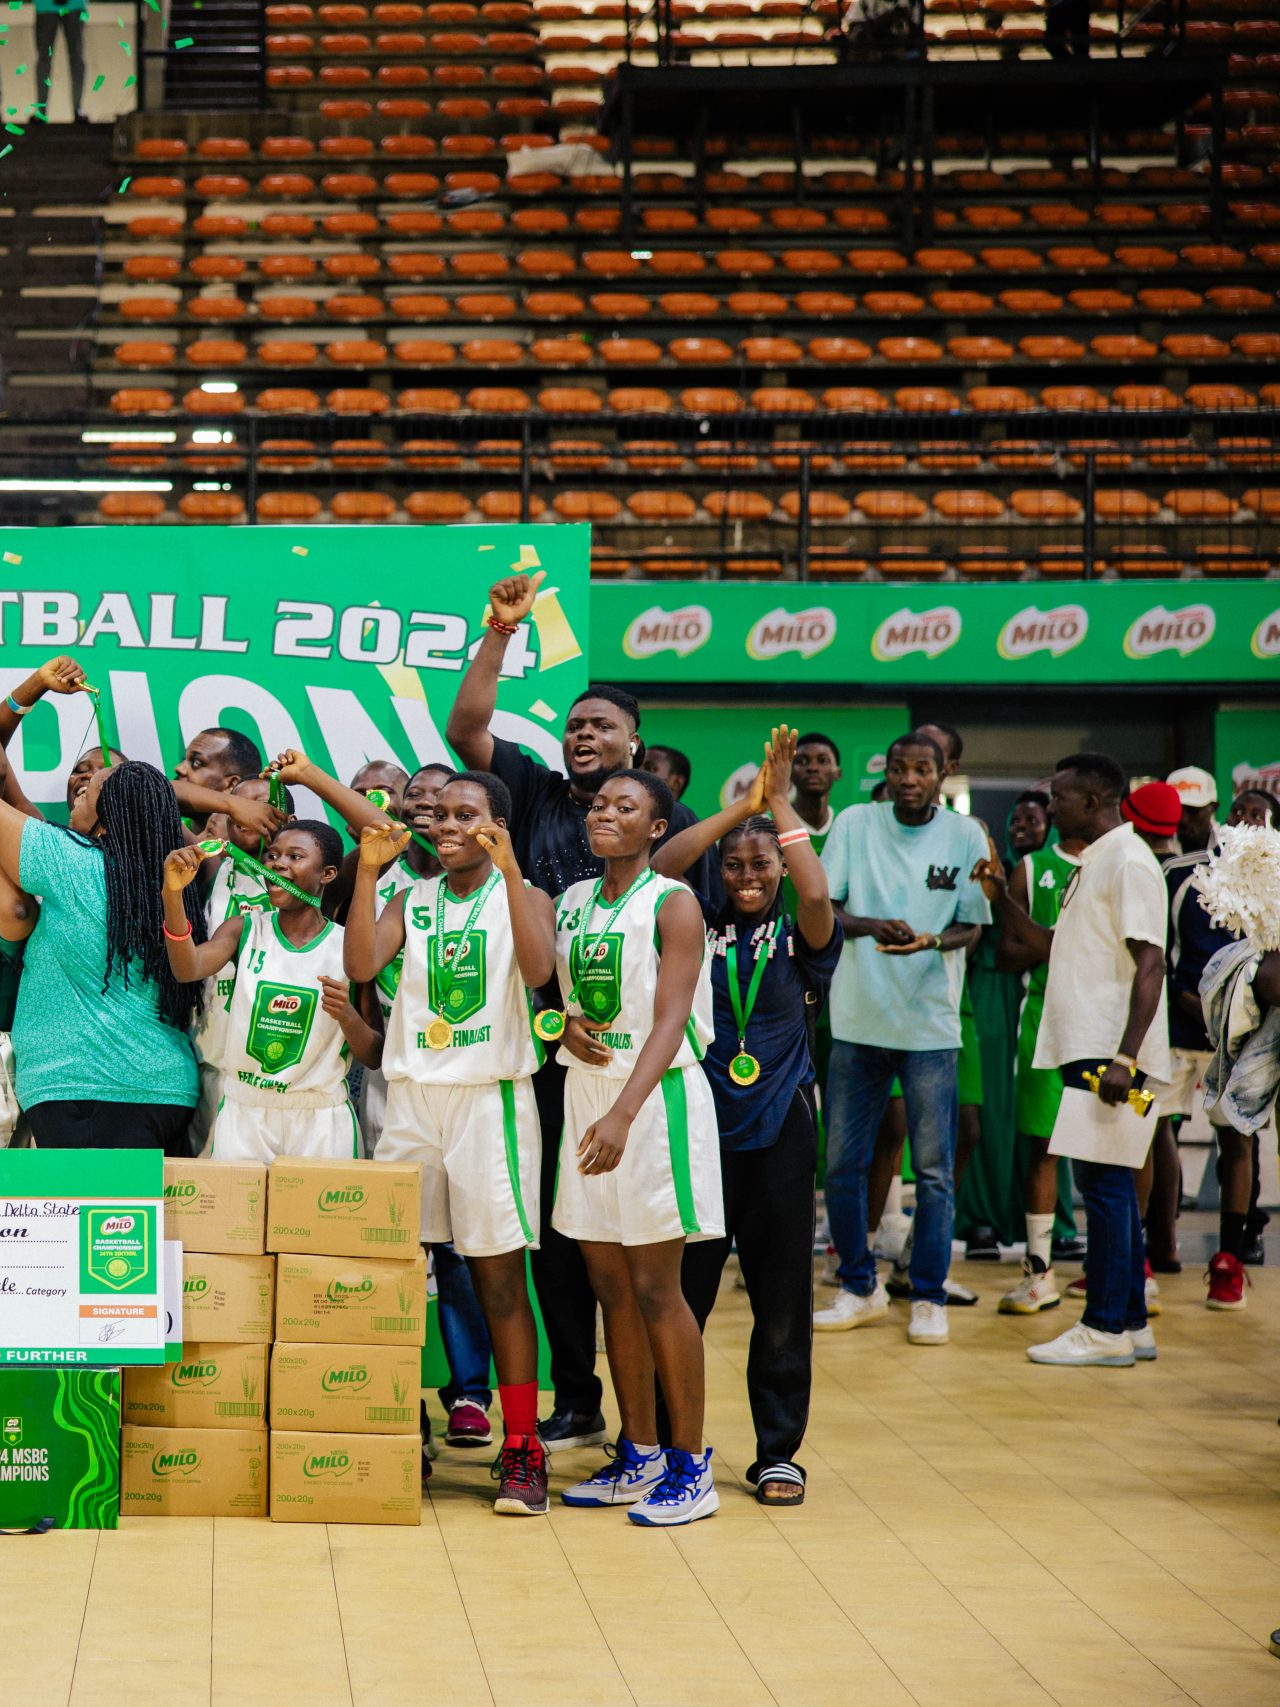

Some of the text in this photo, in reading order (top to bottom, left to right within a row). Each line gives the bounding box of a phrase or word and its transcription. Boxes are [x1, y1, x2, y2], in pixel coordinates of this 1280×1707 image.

[637, 621, 702, 644] MILO
[761, 622, 827, 646] MILO
[886, 622, 952, 646] MILO
[1012, 621, 1079, 645] MILO
[1138, 620, 1206, 644] MILO
[272, 600, 539, 679] 2024
[1038, 869, 1056, 889] 4
[412, 906, 432, 931] 5
[558, 907, 581, 932] 13
[247, 948, 266, 974] 15
[272, 1000, 298, 1010] MILO
[257, 1022, 304, 1035] CHAMPIONSHIP
[260, 1016, 302, 1029] BASKETBALL
[453, 1025, 491, 1048] FINALIST
[325, 1190, 364, 1204] MILO
[4, 1202, 38, 1217] Delta
[105, 1221, 132, 1231] MILO
[273, 1226, 311, 1237] 200x20g
[26, 1287, 67, 1297] Category
[183, 1280, 207, 1292] ILO
[92, 1308, 145, 1316] SIGNATURE
[283, 1317, 320, 1327] 200x20g
[6, 1350, 88, 1361] FURTHER
[178, 1364, 217, 1379] MILO
[329, 1370, 367, 1384] MILO
[128, 1402, 165, 1412] 200x20g
[277, 1408, 315, 1418] 200x20g
[12, 1448, 48, 1464] MSBC
[159, 1453, 197, 1468] MILO
[310, 1455, 349, 1469] MILO
[125, 1492, 162, 1502] 200x20g
[276, 1495, 314, 1504] 200x20g
